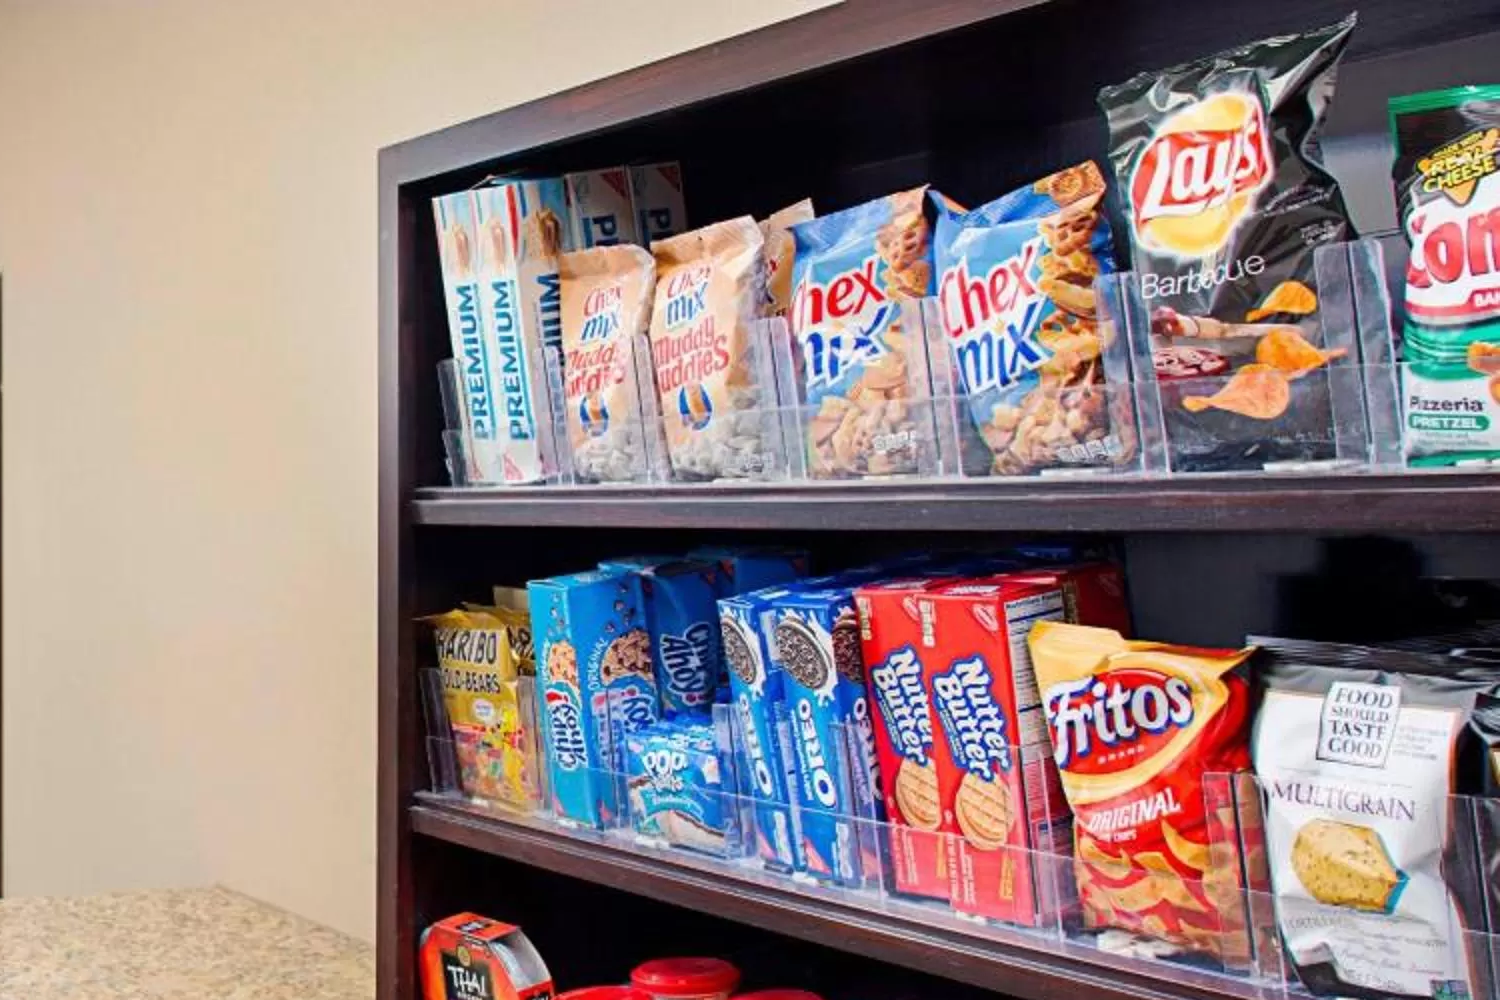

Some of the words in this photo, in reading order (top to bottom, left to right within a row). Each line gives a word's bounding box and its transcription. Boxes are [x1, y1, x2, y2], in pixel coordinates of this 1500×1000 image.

[1423, 156, 1495, 193] CHEESE
[941, 246, 1039, 340] Chex
[1141, 254, 1267, 300] Barbecue
[453, 282, 491, 441] PREMIUM
[490, 279, 530, 441] PREMIUM
[657, 334, 730, 393] uddies
[956, 299, 1046, 392] mix
[1409, 395, 1484, 413] Pizzeria
[1411, 416, 1479, 430] PRETZEL
[436, 629, 498, 665] HARIBO
[442, 667, 501, 694] OLD-BEARS
[1335, 687, 1394, 709] FOOD
[872, 665, 928, 766] Butter
[933, 674, 994, 782] Butter
[953, 656, 1011, 772] Nutter
[1048, 677, 1193, 769] Fritos
[1328, 719, 1387, 741] TASTE
[1331, 706, 1389, 723] SHOULD
[798, 699, 837, 808] OREO
[1328, 737, 1382, 759] GOOD
[1086, 787, 1182, 832] ORIGINAL
[1271, 779, 1416, 822] MULTIGRAIN
[447, 965, 487, 996] THAI
